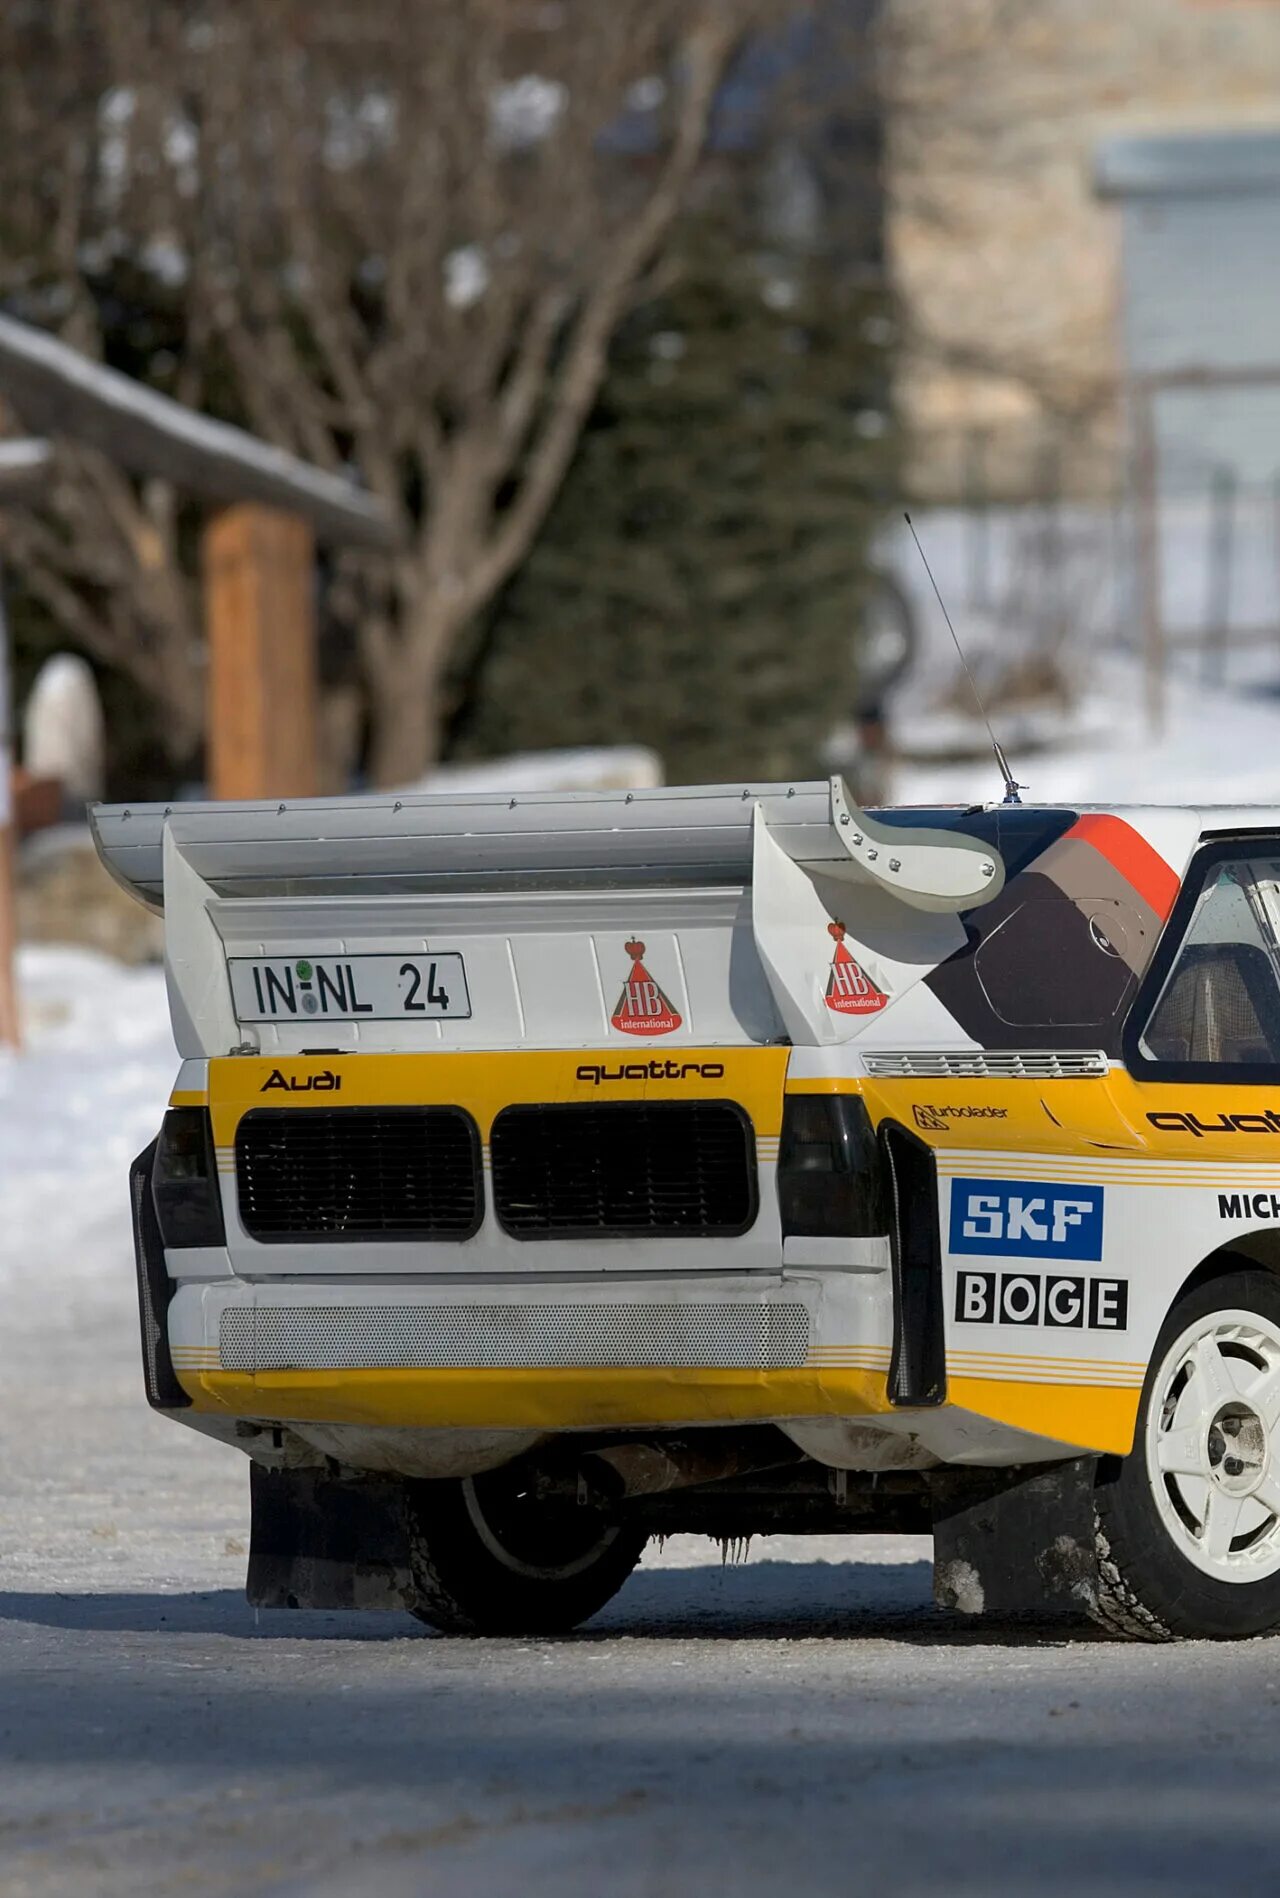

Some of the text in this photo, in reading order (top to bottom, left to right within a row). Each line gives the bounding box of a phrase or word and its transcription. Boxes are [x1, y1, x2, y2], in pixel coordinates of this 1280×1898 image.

[400, 963, 449, 1011] 24
[829, 962, 869, 997] HB
[621, 980, 664, 1017] HB
[833, 997, 881, 1009] international
[620, 1018, 674, 1030] international
[259, 1069, 342, 1092] Audi
[576, 1060, 724, 1085] quattro
[923, 1105, 1009, 1118] Turbolader
[963, 1195, 1093, 1242] SKF
[963, 1275, 1119, 1326] BOGE
